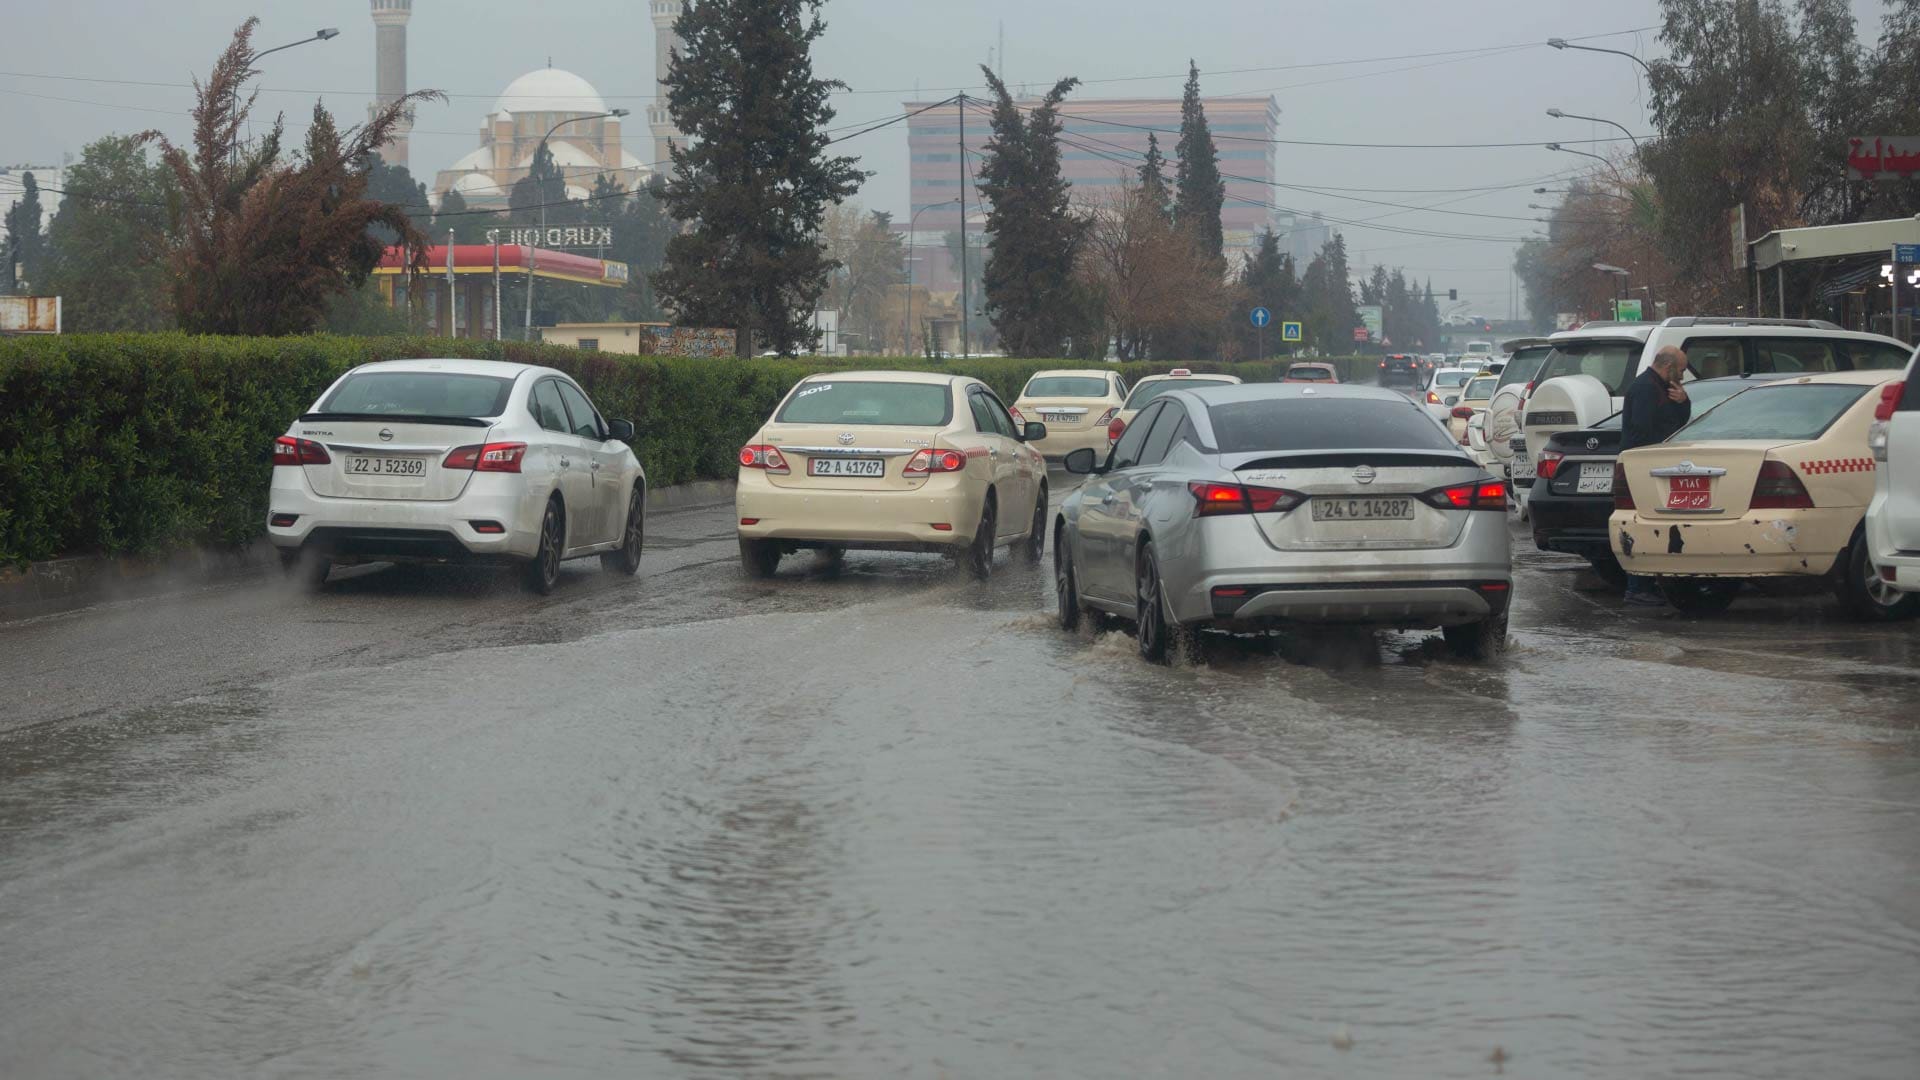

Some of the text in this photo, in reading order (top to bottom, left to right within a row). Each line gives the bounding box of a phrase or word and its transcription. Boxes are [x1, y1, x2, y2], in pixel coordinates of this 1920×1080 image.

[798, 384, 833, 398] 2012
[354, 458, 423, 474] 22 J 52369
[817, 460, 879, 474] 22 A 41767
[1679, 478, 1700, 489] ٧٦٨٢
[1324, 500, 1409, 518] 24 C 14287
